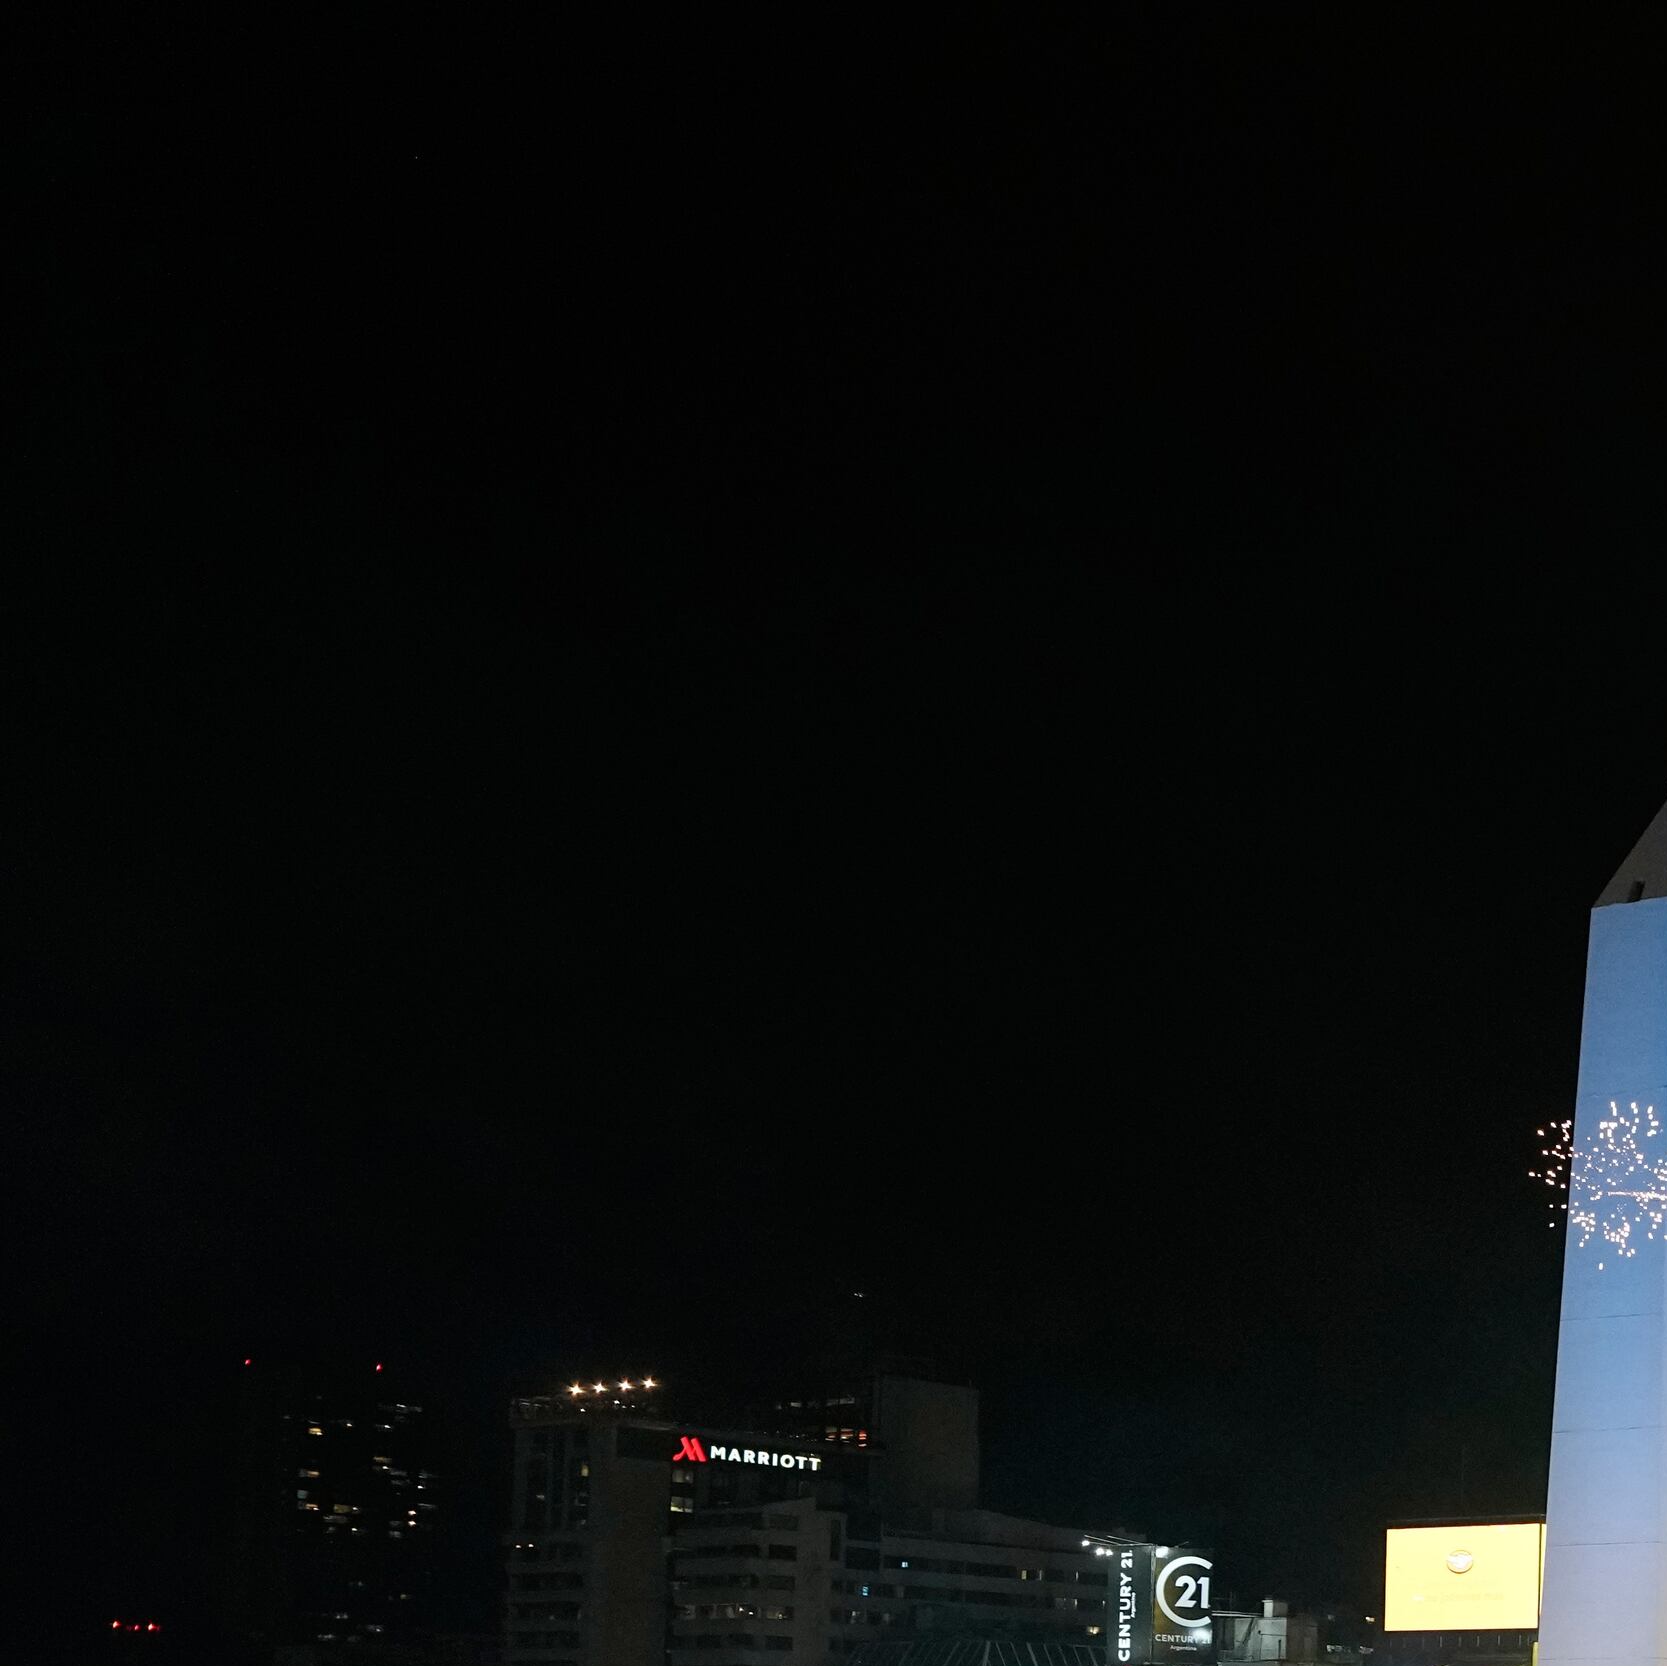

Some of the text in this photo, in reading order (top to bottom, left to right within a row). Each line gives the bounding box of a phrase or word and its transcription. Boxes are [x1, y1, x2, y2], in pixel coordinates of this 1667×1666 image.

[710, 1445, 821, 1471] MARRIOTT
[1118, 1573, 1133, 1661] CENTURY
[1155, 1634, 1199, 1643] CENTURY
